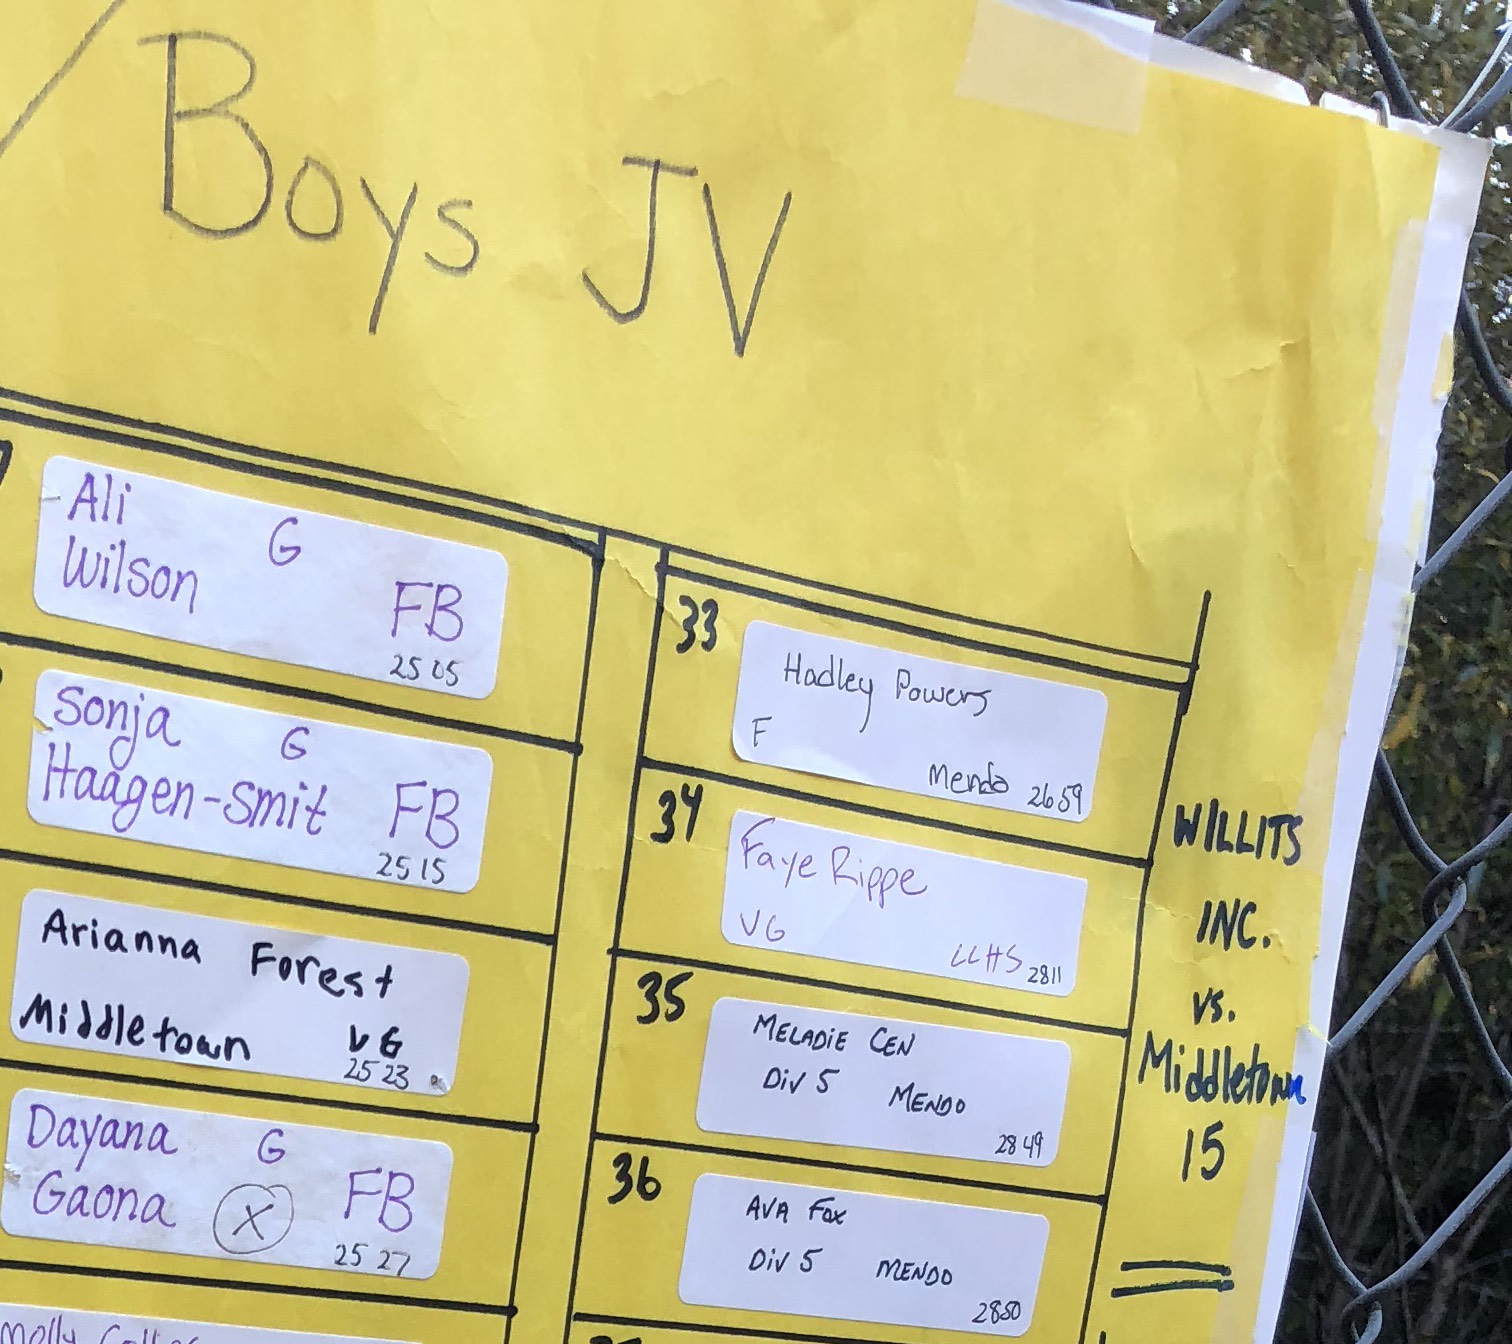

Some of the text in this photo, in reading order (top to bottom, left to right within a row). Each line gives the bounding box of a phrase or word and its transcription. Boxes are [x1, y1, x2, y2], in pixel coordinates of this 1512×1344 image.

[582, 156, 792, 358] JV
[68, 472, 301, 566] Ali G
[63, 535, 198, 614] Wilson
[676, 595, 719, 654] 33
[784, 653, 991, 733] Hadley Powers
[51, 686, 181, 771] Sonja
[752, 716, 772, 747] F
[922, 762, 1009, 800] Mendo
[389, 781, 459, 849] FB
[650, 783, 703, 844] 34
[1174, 798, 1303, 866] WILLITS
[741, 818, 927, 909] Faye Rippe
[42, 908, 393, 999] Arianna Forest
[1197, 898, 1271, 951] INC.
[19, 993, 250, 1063] Middletown
[1138, 1030, 1306, 1107] Middletown
[27, 1104, 178, 1172] Dayana
[1182, 1120, 1225, 1182] 15
[33, 1167, 414, 1233] Gaona FB
[607, 1152, 661, 1204] 36
